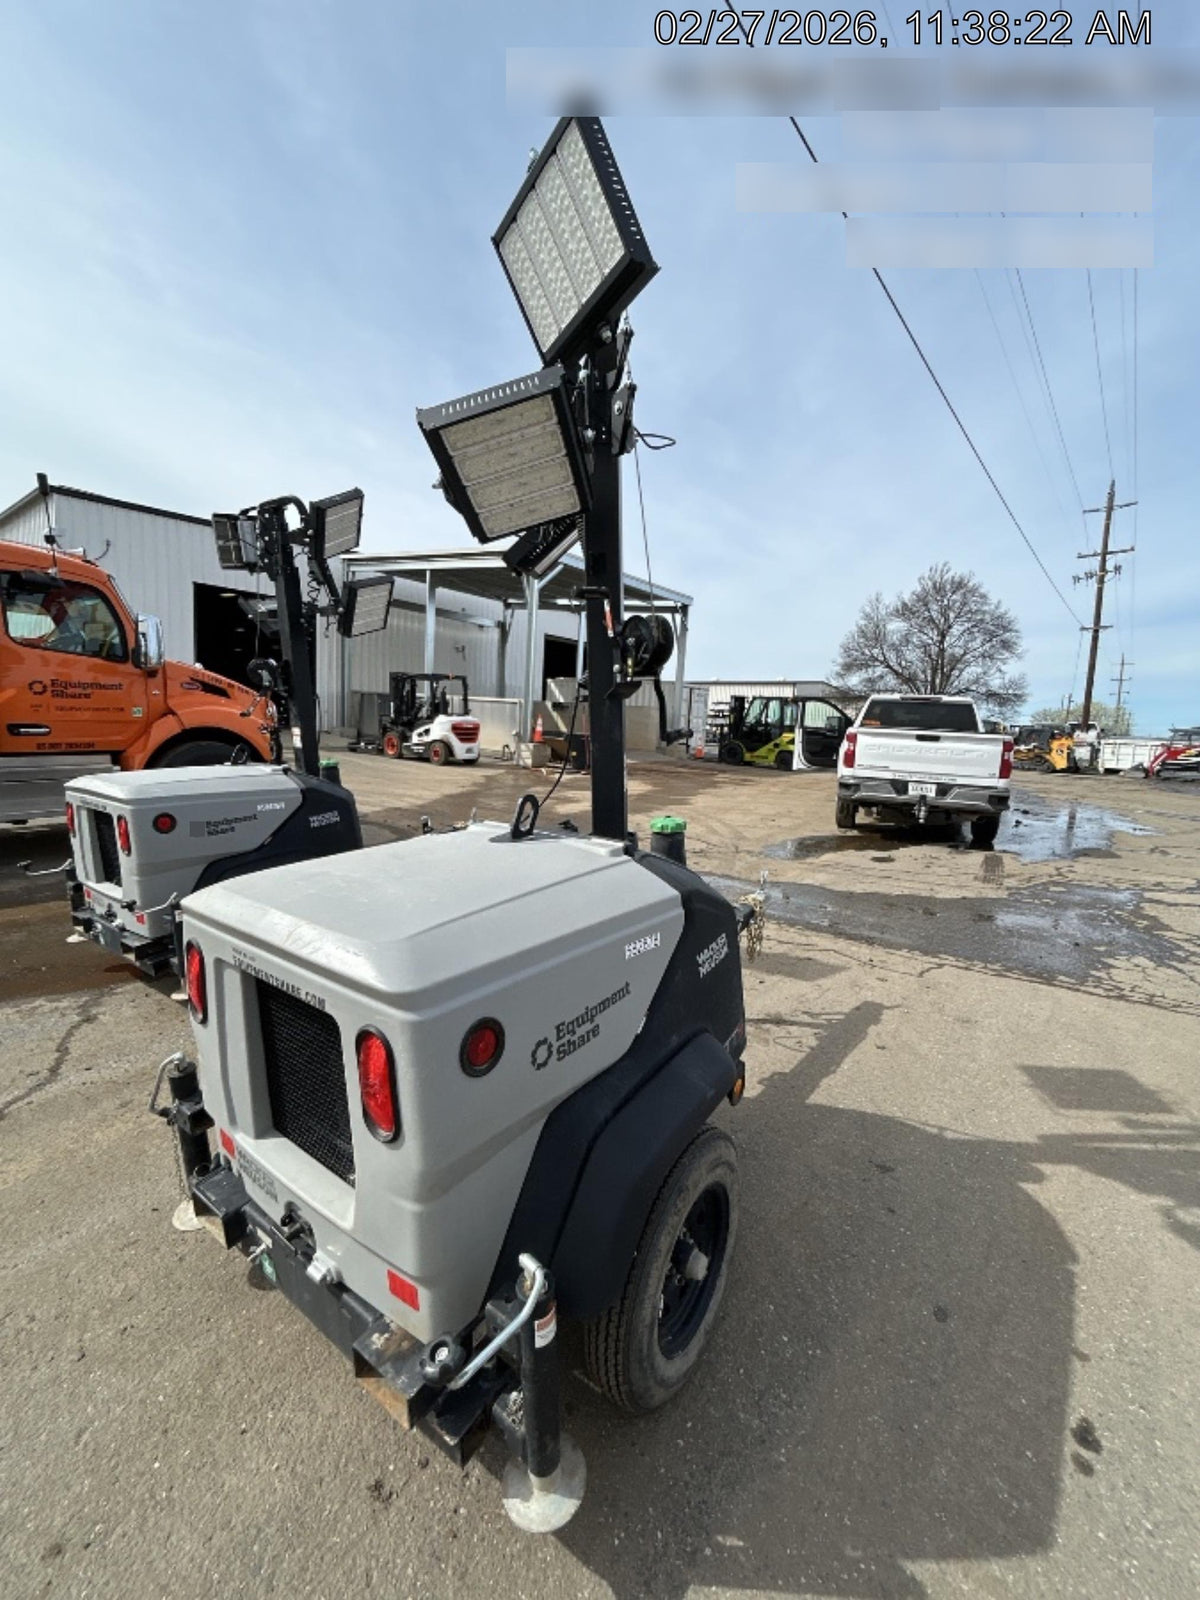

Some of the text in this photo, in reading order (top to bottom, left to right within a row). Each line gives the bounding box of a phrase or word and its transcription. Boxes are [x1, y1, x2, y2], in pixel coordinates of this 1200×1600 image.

[50, 679, 124, 691] Equipment
[51, 689, 92, 699] Share
[554, 981, 631, 1042] Equipment
[555, 1023, 600, 1062] Share
